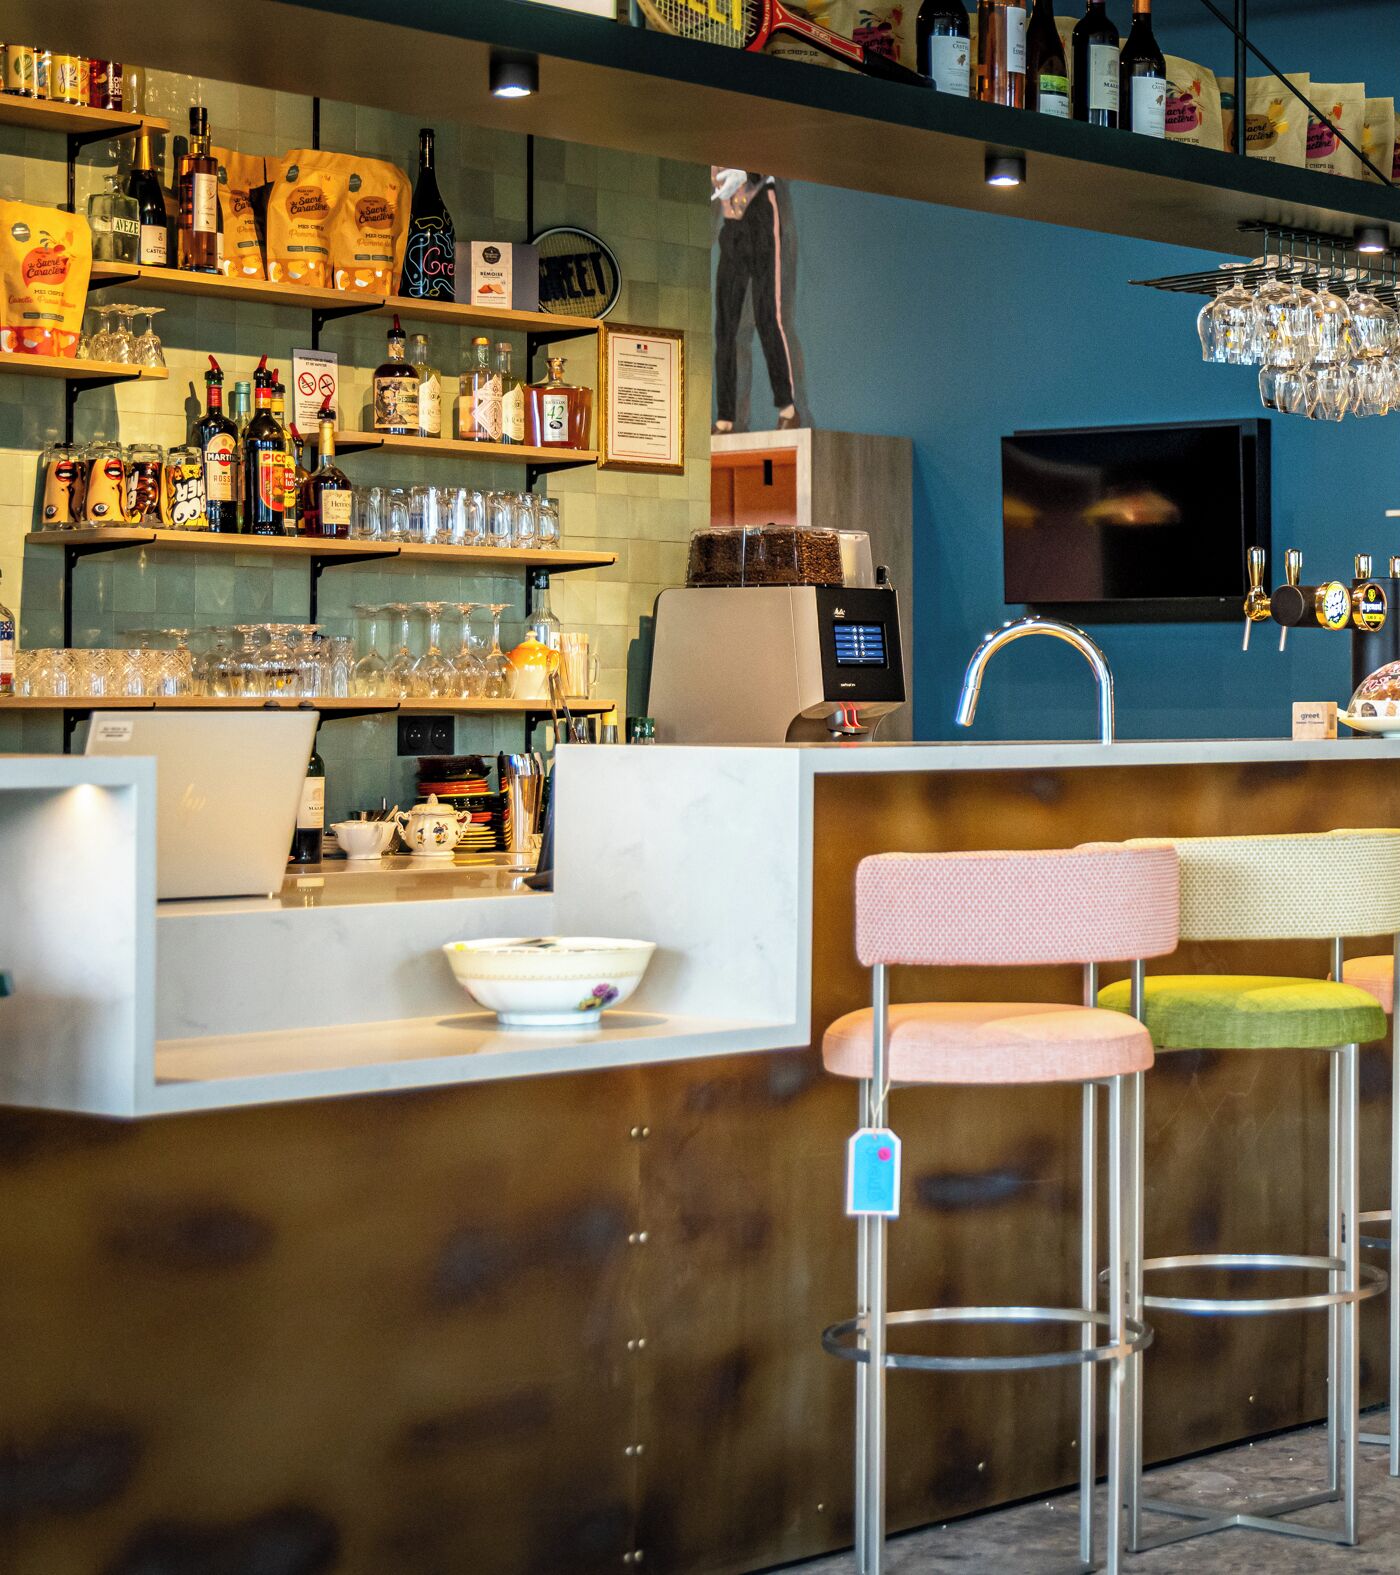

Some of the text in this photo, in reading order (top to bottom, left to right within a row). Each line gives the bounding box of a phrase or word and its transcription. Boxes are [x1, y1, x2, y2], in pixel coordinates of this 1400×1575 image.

[299, 195, 323, 206] Sacré
[116, 219, 139, 234] AVEZE
[36, 257, 61, 269] Sacré
[547, 405, 564, 419] 42
[1301, 712, 1320, 721] greet
